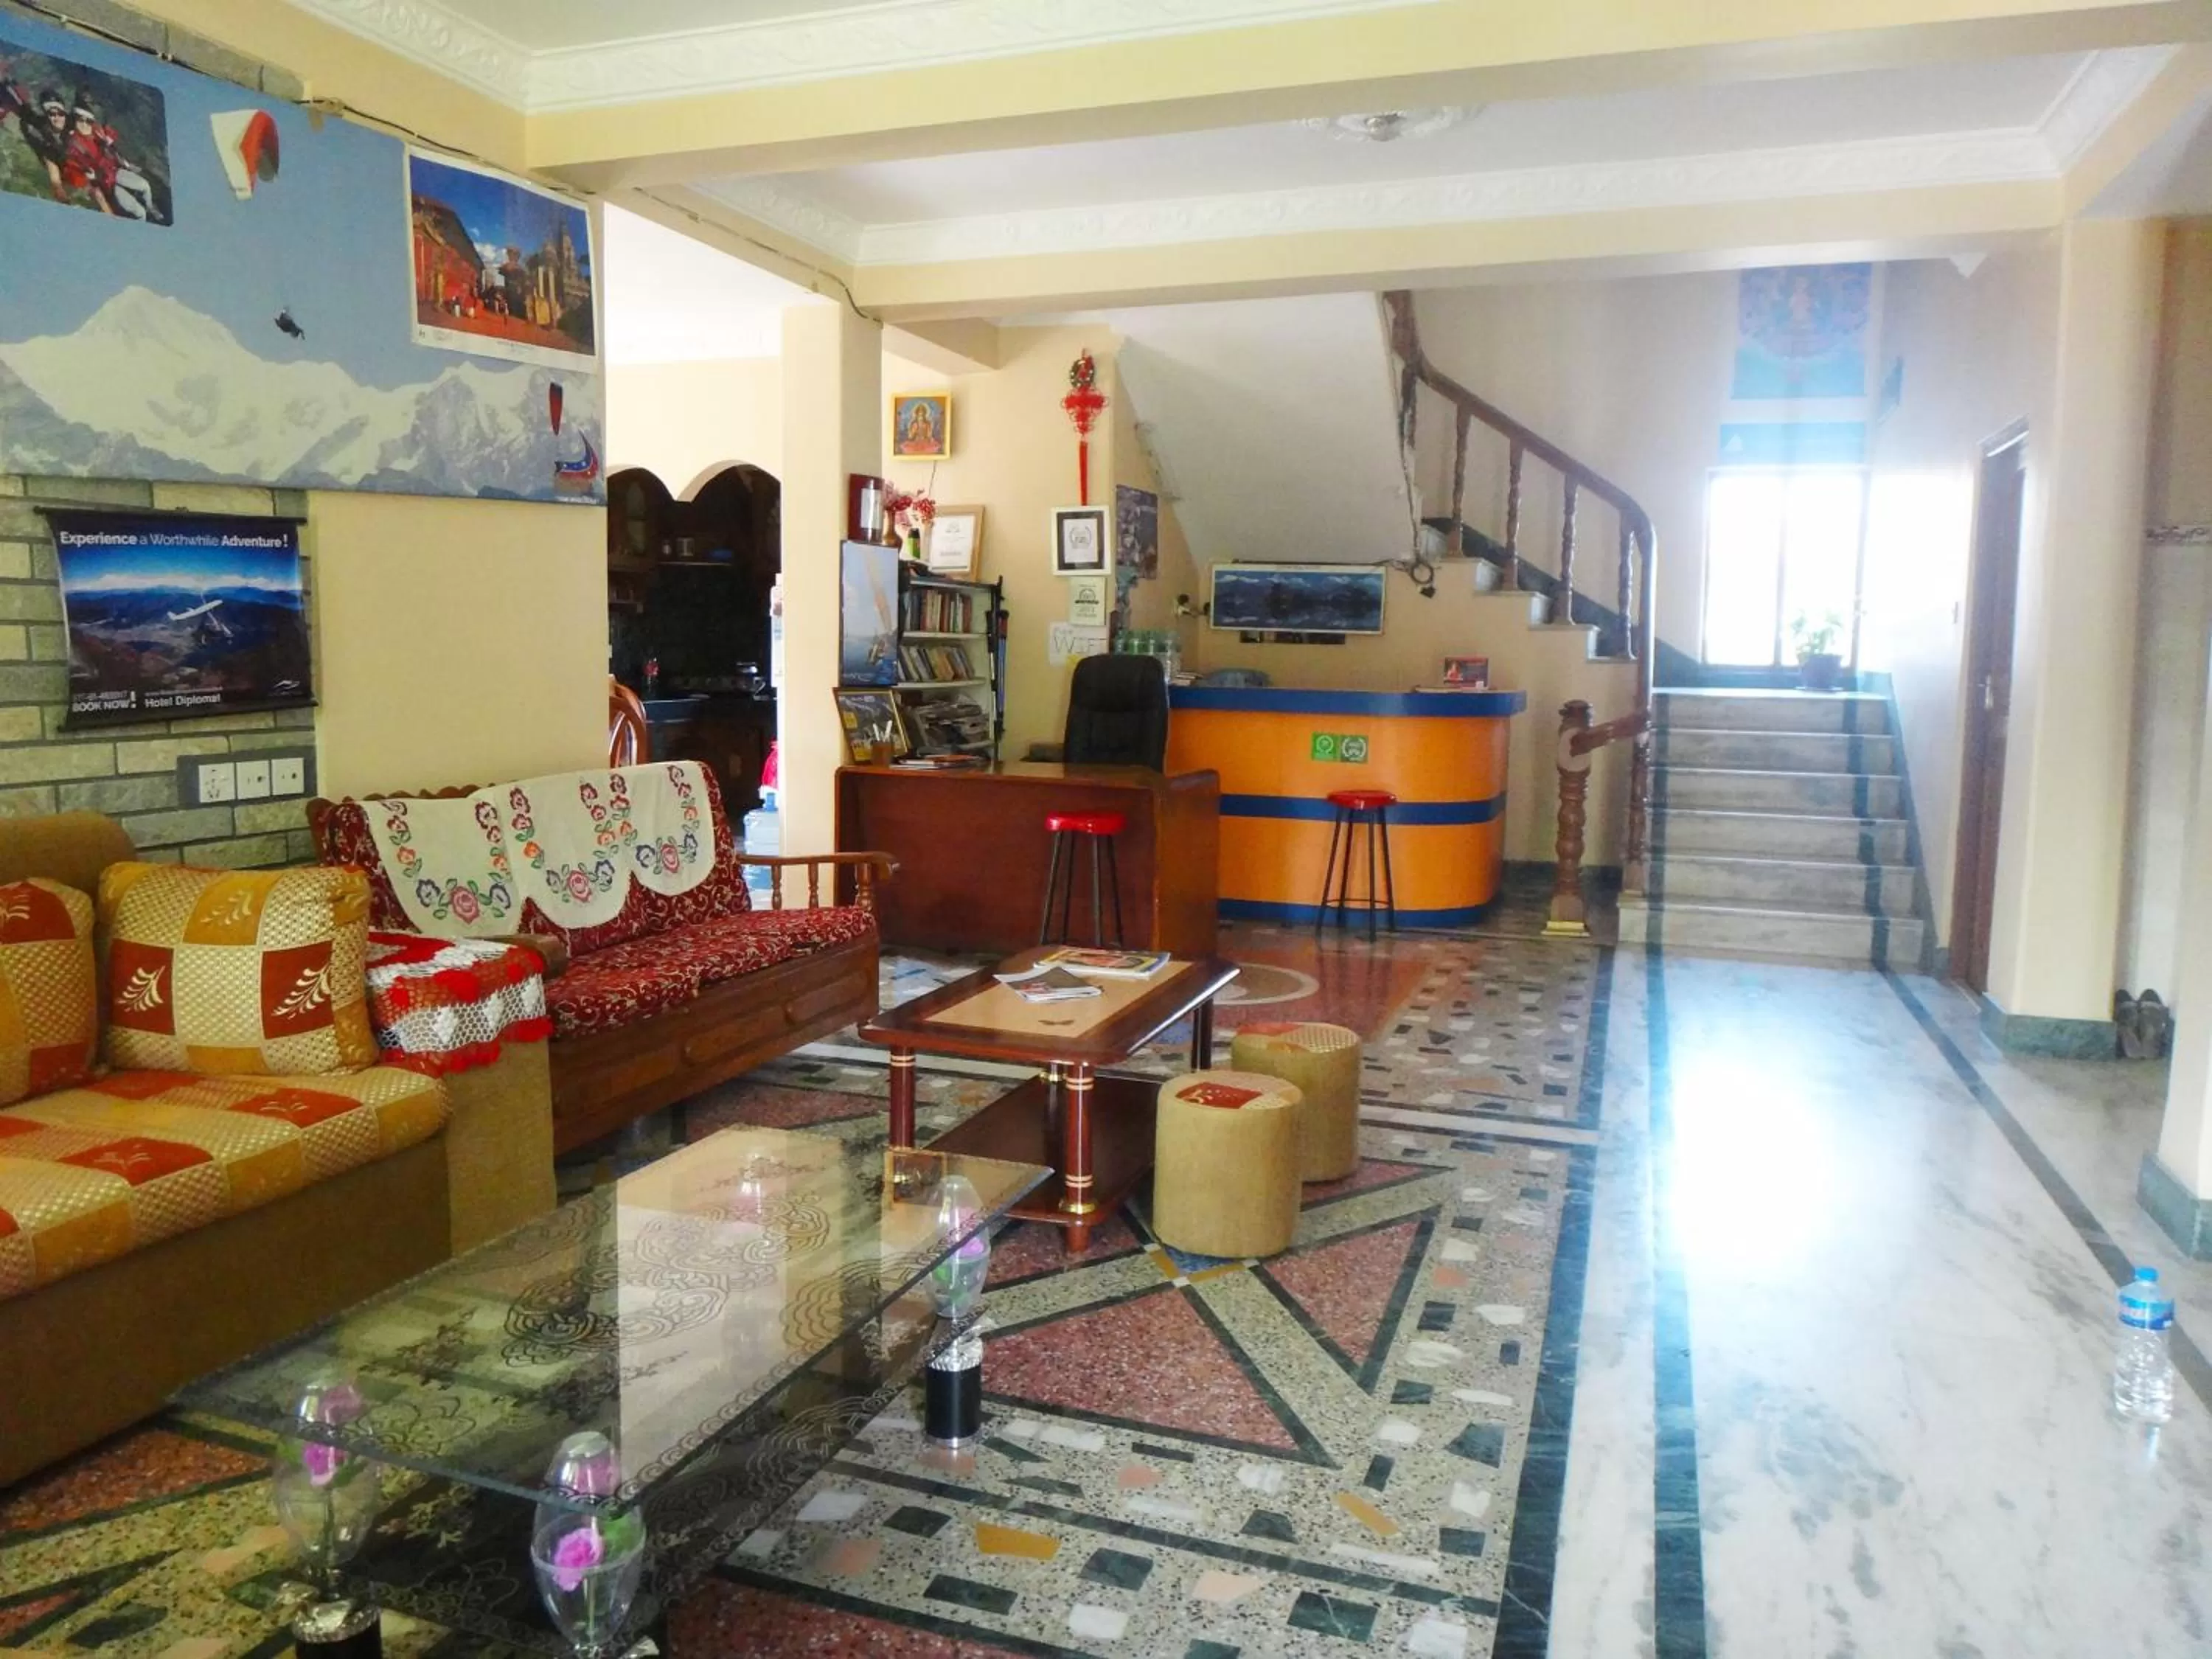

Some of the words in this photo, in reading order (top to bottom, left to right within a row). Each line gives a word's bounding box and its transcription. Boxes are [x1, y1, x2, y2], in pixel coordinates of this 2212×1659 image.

[60, 531, 138, 548] Experience
[139, 536, 147, 545] a
[150, 533, 219, 546] Worthwhile
[72, 701, 102, 713] BOOK
[145, 696, 173, 708] Hotel
